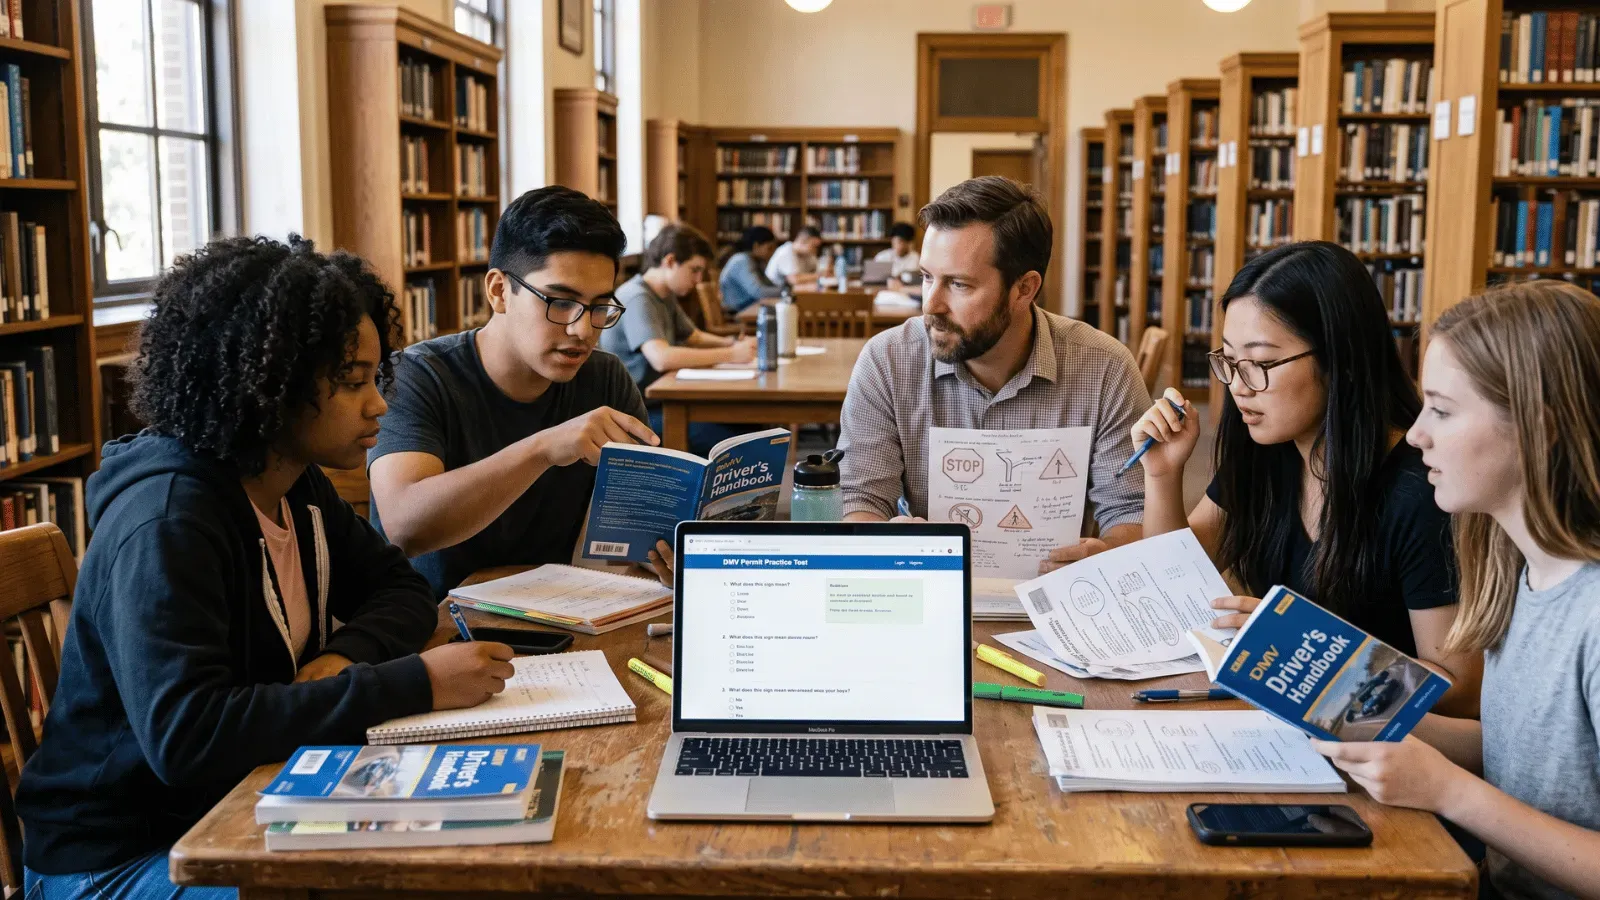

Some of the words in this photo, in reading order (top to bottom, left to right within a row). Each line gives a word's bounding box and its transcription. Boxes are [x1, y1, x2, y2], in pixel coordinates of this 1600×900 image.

[713, 461, 769, 488] Driver's
[946, 458, 980, 473] STOP
[710, 472, 773, 499] Handbook
[722, 558, 739, 566] DMV
[741, 558, 763, 566] Permit
[764, 558, 792, 566] Practice
[1249, 644, 1279, 681] DMV
[1265, 629, 1327, 696] Driver's
[1286, 634, 1351, 705] Handbook
[427, 751, 465, 791] Handbook
[453, 750, 491, 788] Driver's
